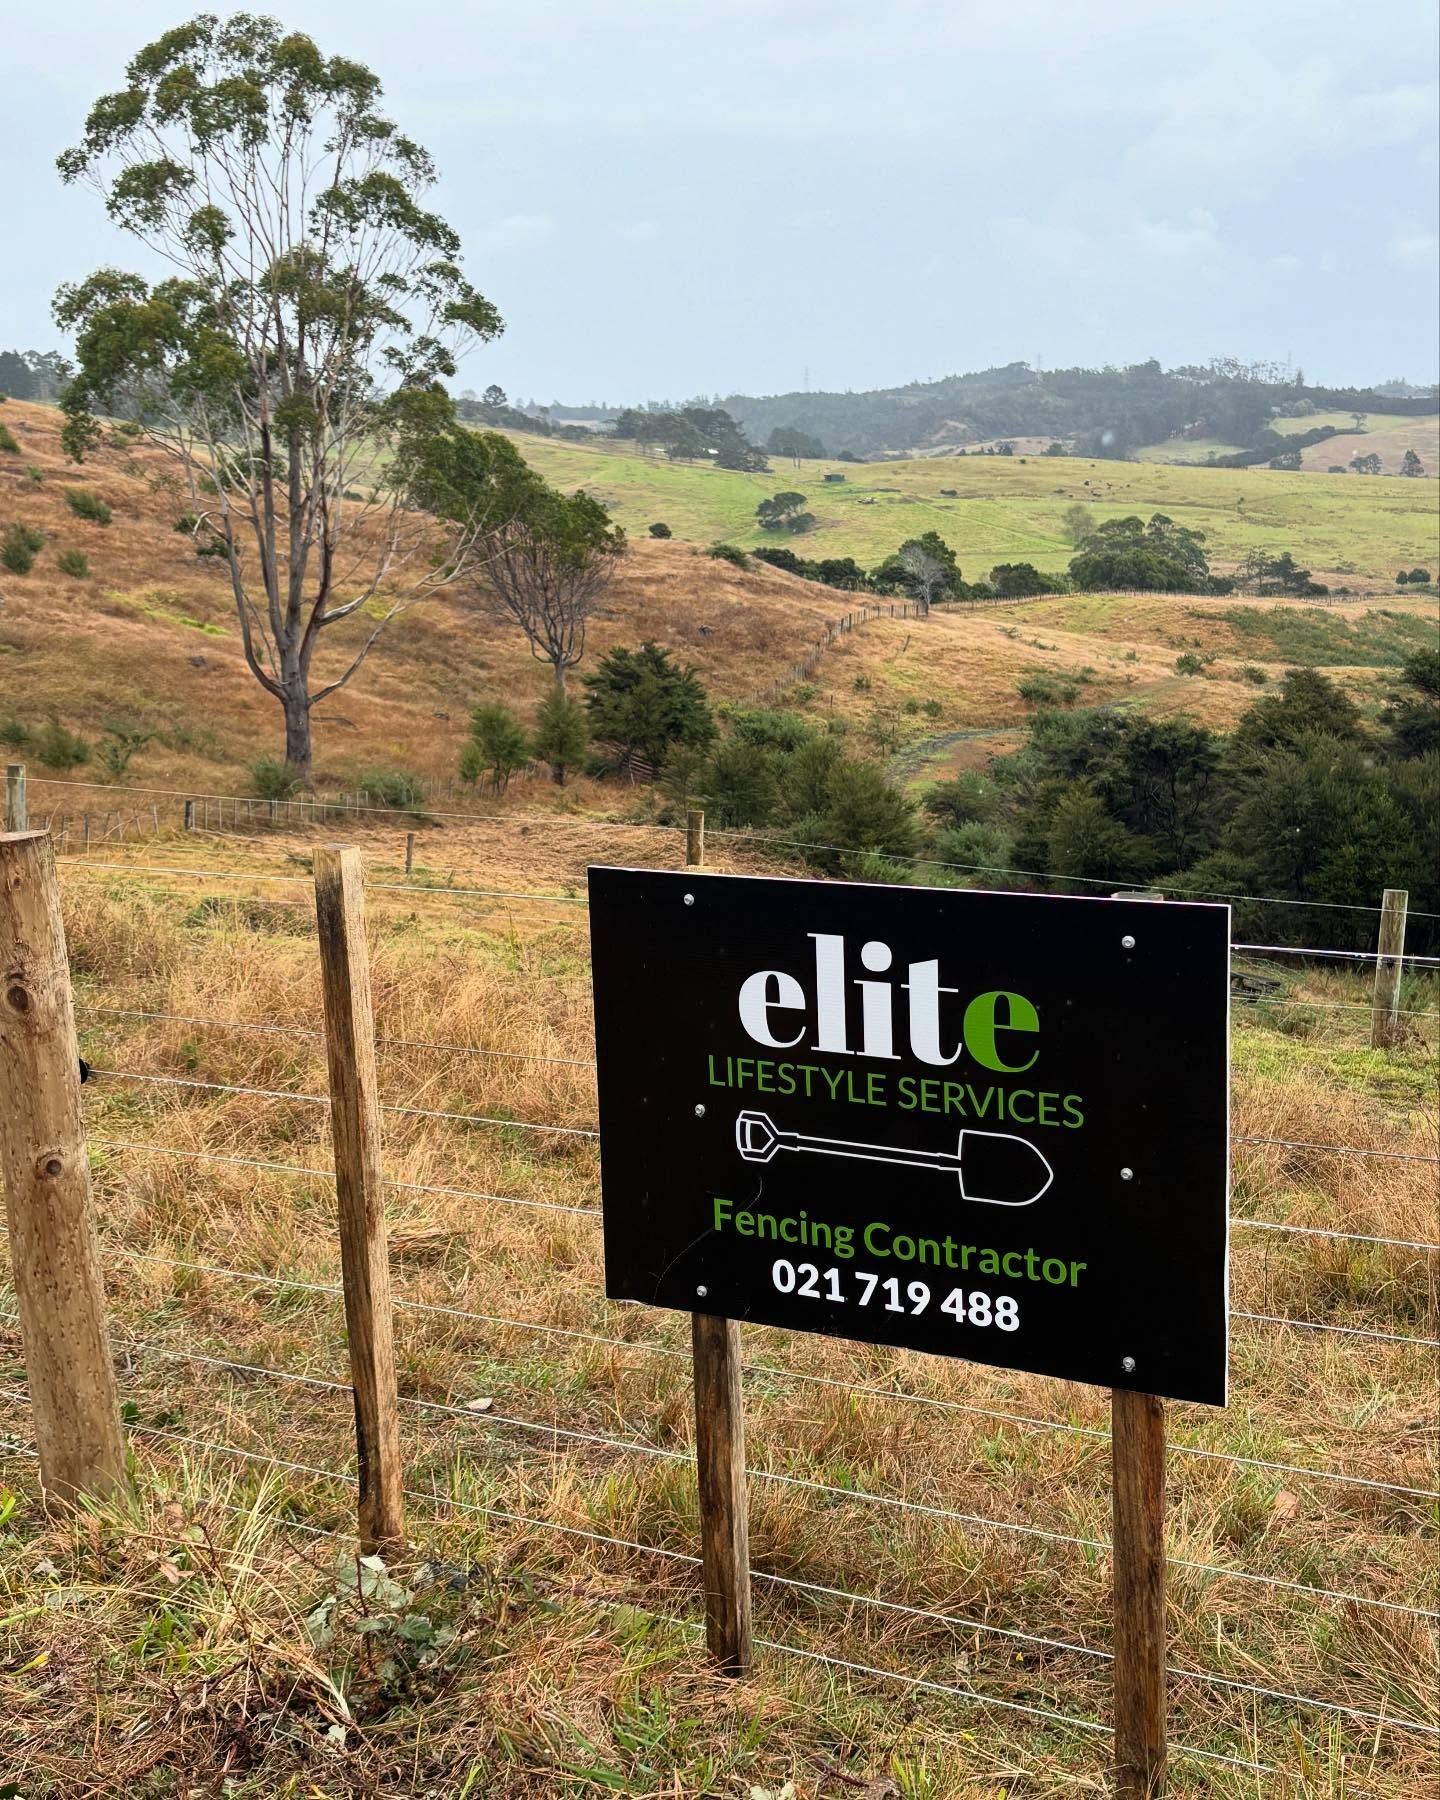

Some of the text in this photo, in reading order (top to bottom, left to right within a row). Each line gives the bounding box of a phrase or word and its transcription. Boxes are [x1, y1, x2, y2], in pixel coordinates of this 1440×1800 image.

[738, 932, 1040, 1073] elite
[708, 1054, 1084, 1129] LIFESTYLE SERVICES
[713, 1198, 1088, 1287] Fencing Contractor
[771, 1258, 1020, 1332] 021 719 488
